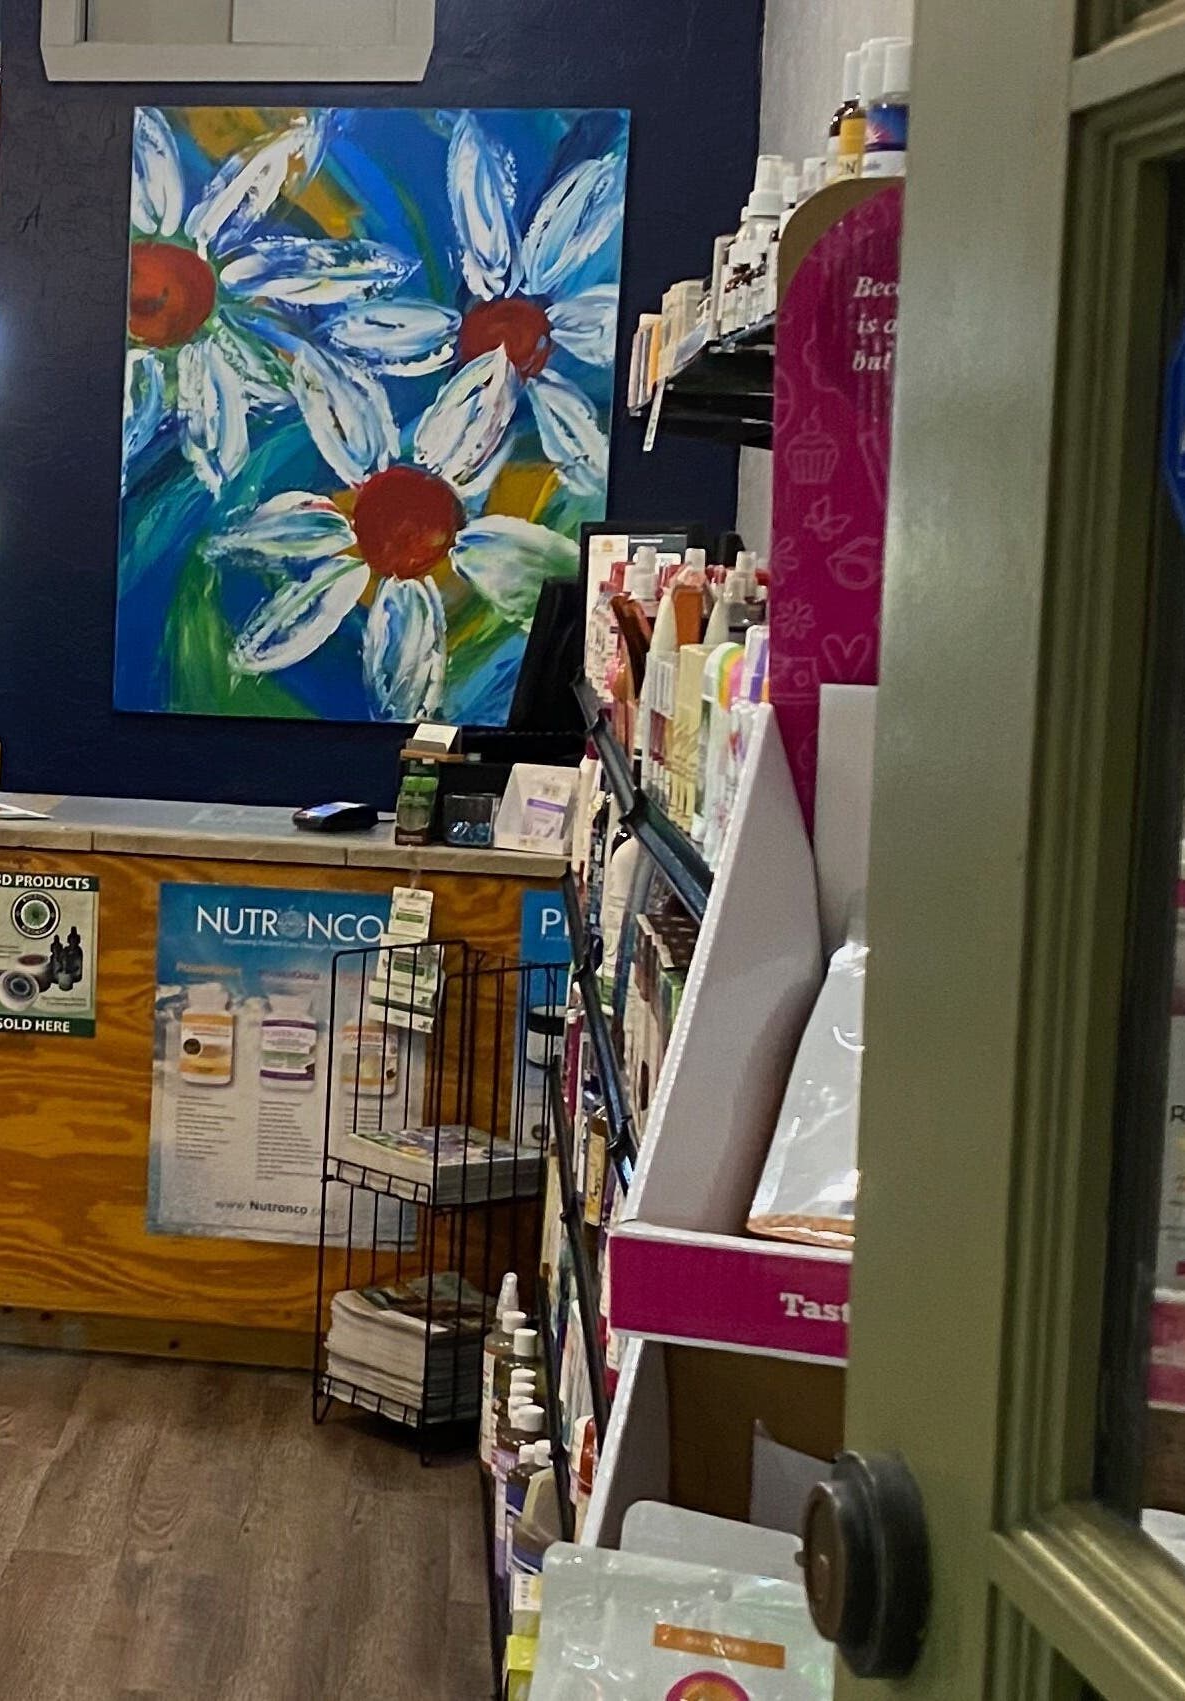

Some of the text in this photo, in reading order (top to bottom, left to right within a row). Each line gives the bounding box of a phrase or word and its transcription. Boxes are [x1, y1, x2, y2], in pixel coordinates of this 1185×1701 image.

[858, 314, 876, 334] is
[852, 350, 892, 371] but
[15, 875, 90, 890] PRODUCTS
[34, 1019, 71, 1033] HERE
[249, 1200, 309, 1215] Nutronco
